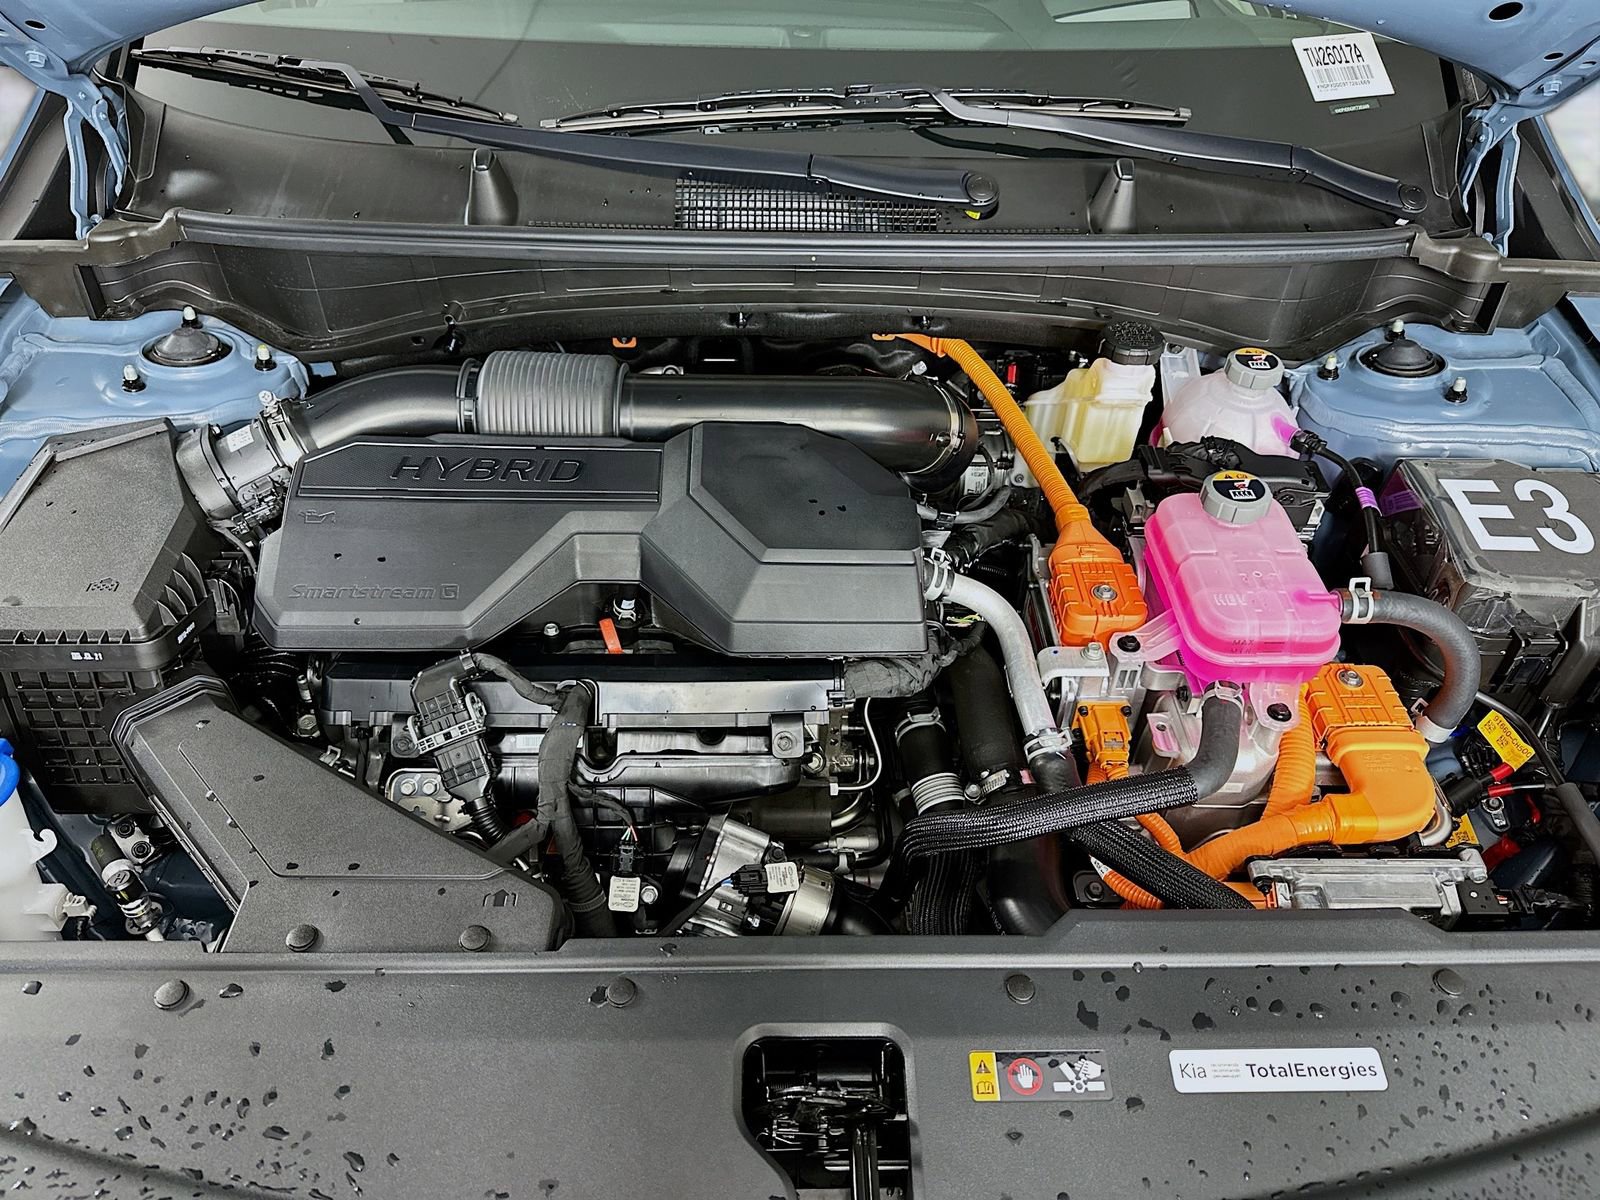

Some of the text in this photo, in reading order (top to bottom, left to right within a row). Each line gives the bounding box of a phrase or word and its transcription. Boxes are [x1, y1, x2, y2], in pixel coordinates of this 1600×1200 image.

[1303, 43, 1365, 67] TW26017A
[389, 456, 585, 483] HYBRID
[1438, 478, 1596, 555] E3
[288, 583, 437, 599] Smartstream
[1493, 715, 1532, 758] 91660-CH500
[1179, 1062, 1378, 1080] Kia TotalEnergies
